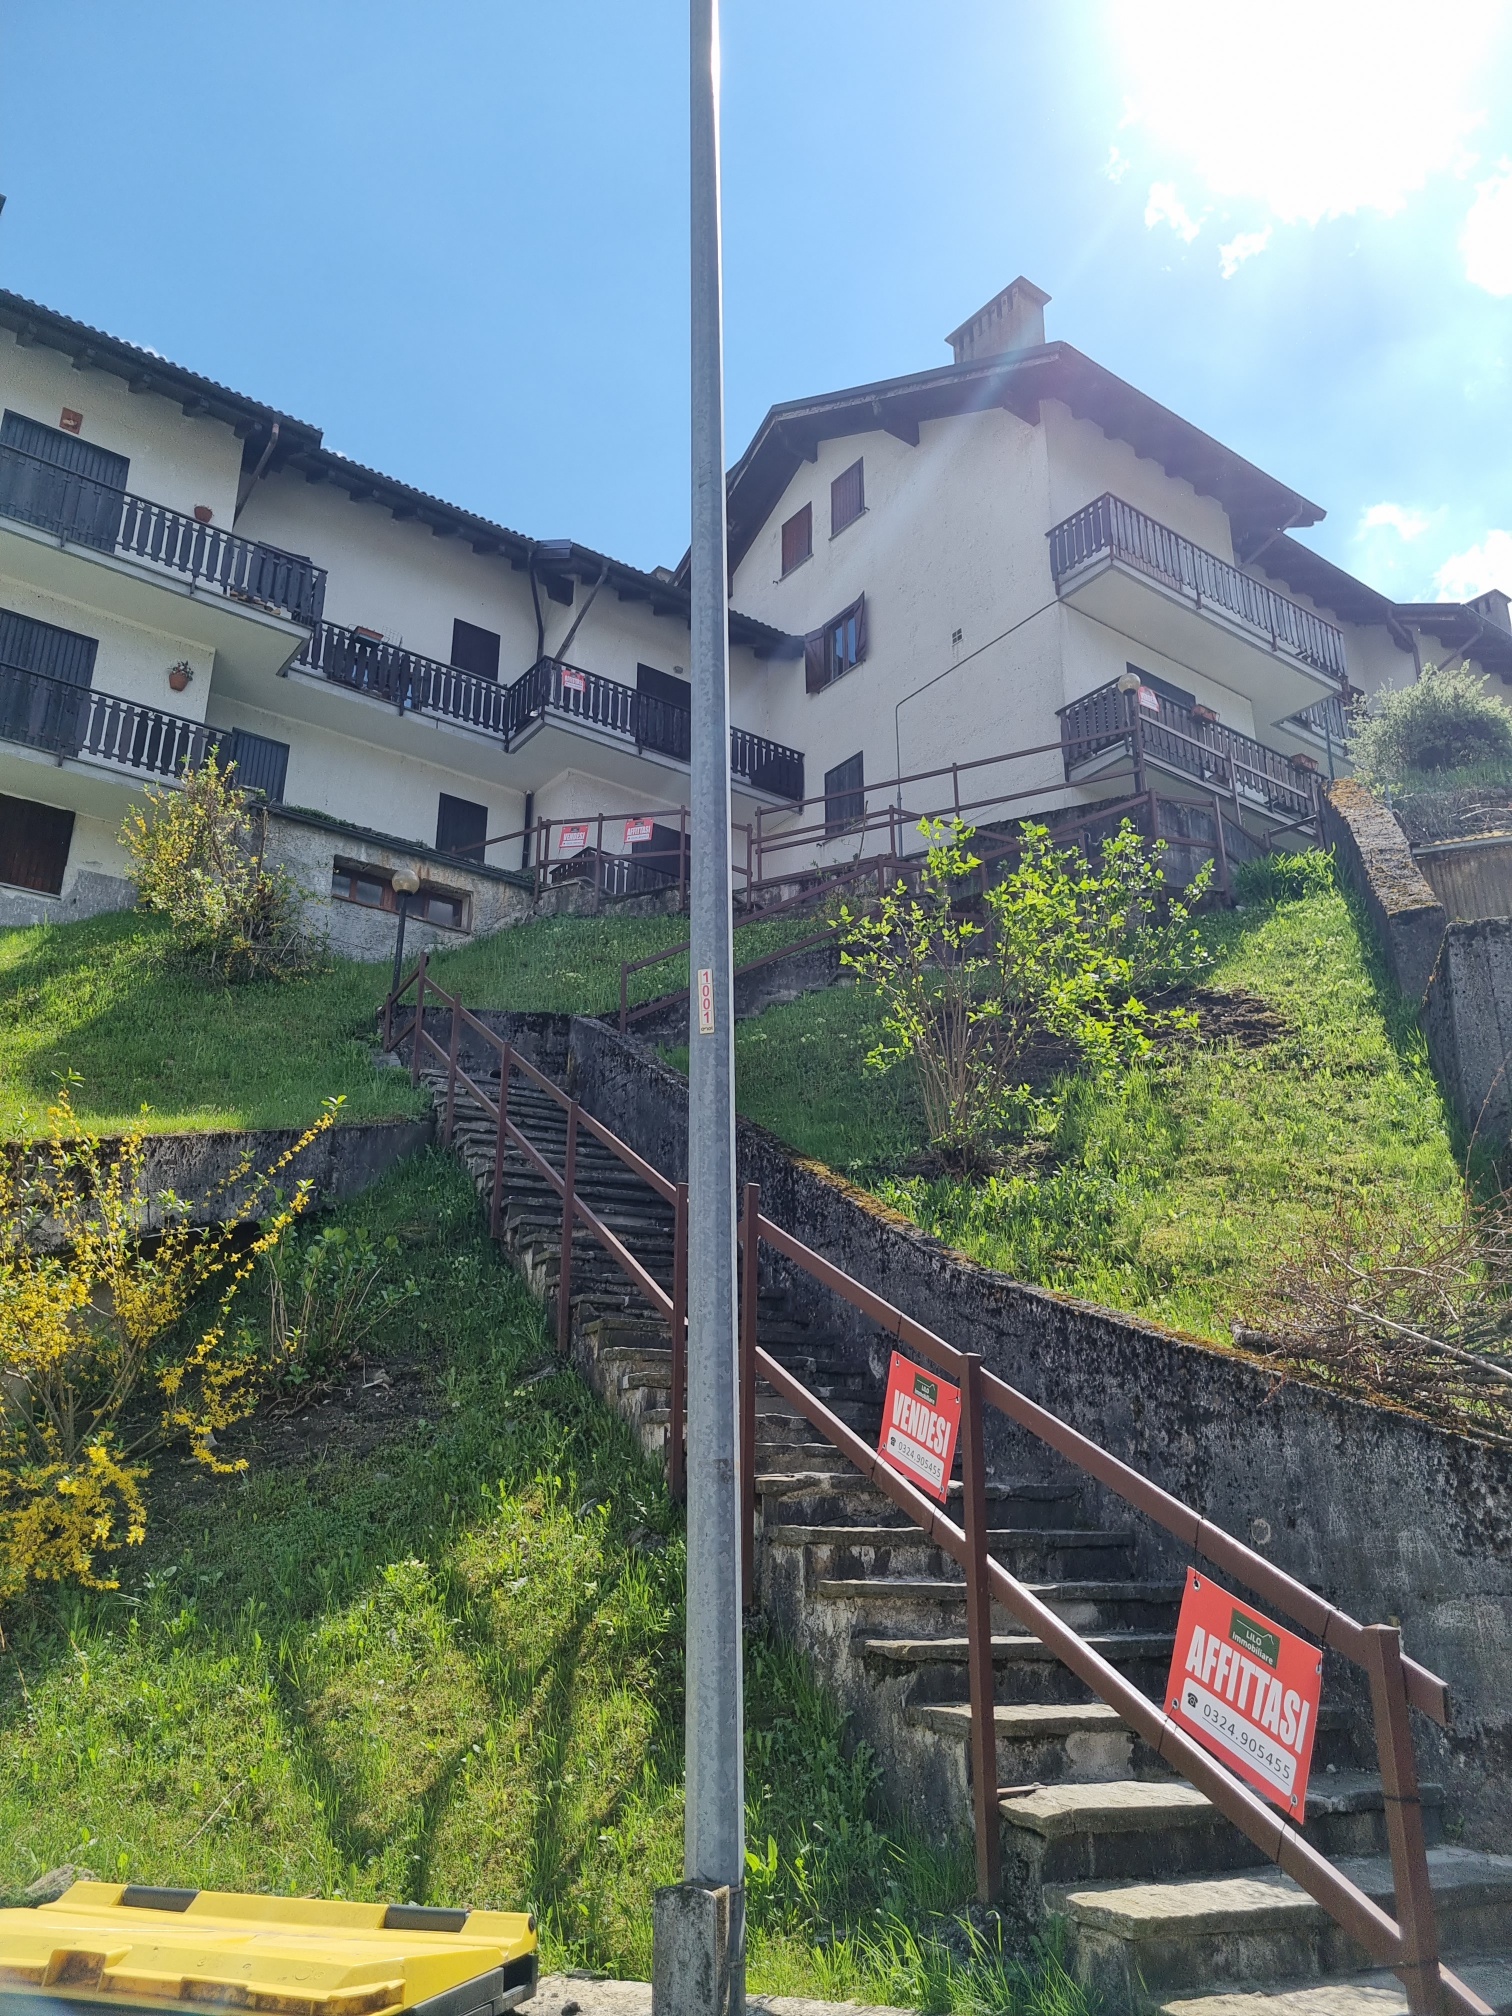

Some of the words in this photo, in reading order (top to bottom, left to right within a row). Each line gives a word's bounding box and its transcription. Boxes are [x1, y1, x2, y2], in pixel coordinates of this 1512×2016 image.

[702, 971, 711, 1024] 1001
[892, 1389, 952, 1459] VENDESI
[898, 1441, 941, 1478] 0324.905455
[1232, 1631, 1274, 1665] Immobiliare
[1246, 1630, 1262, 1646] LILO
[1185, 1624, 1310, 1754] AFFITTASI
[1203, 1704, 1291, 1780] 0324.905455
